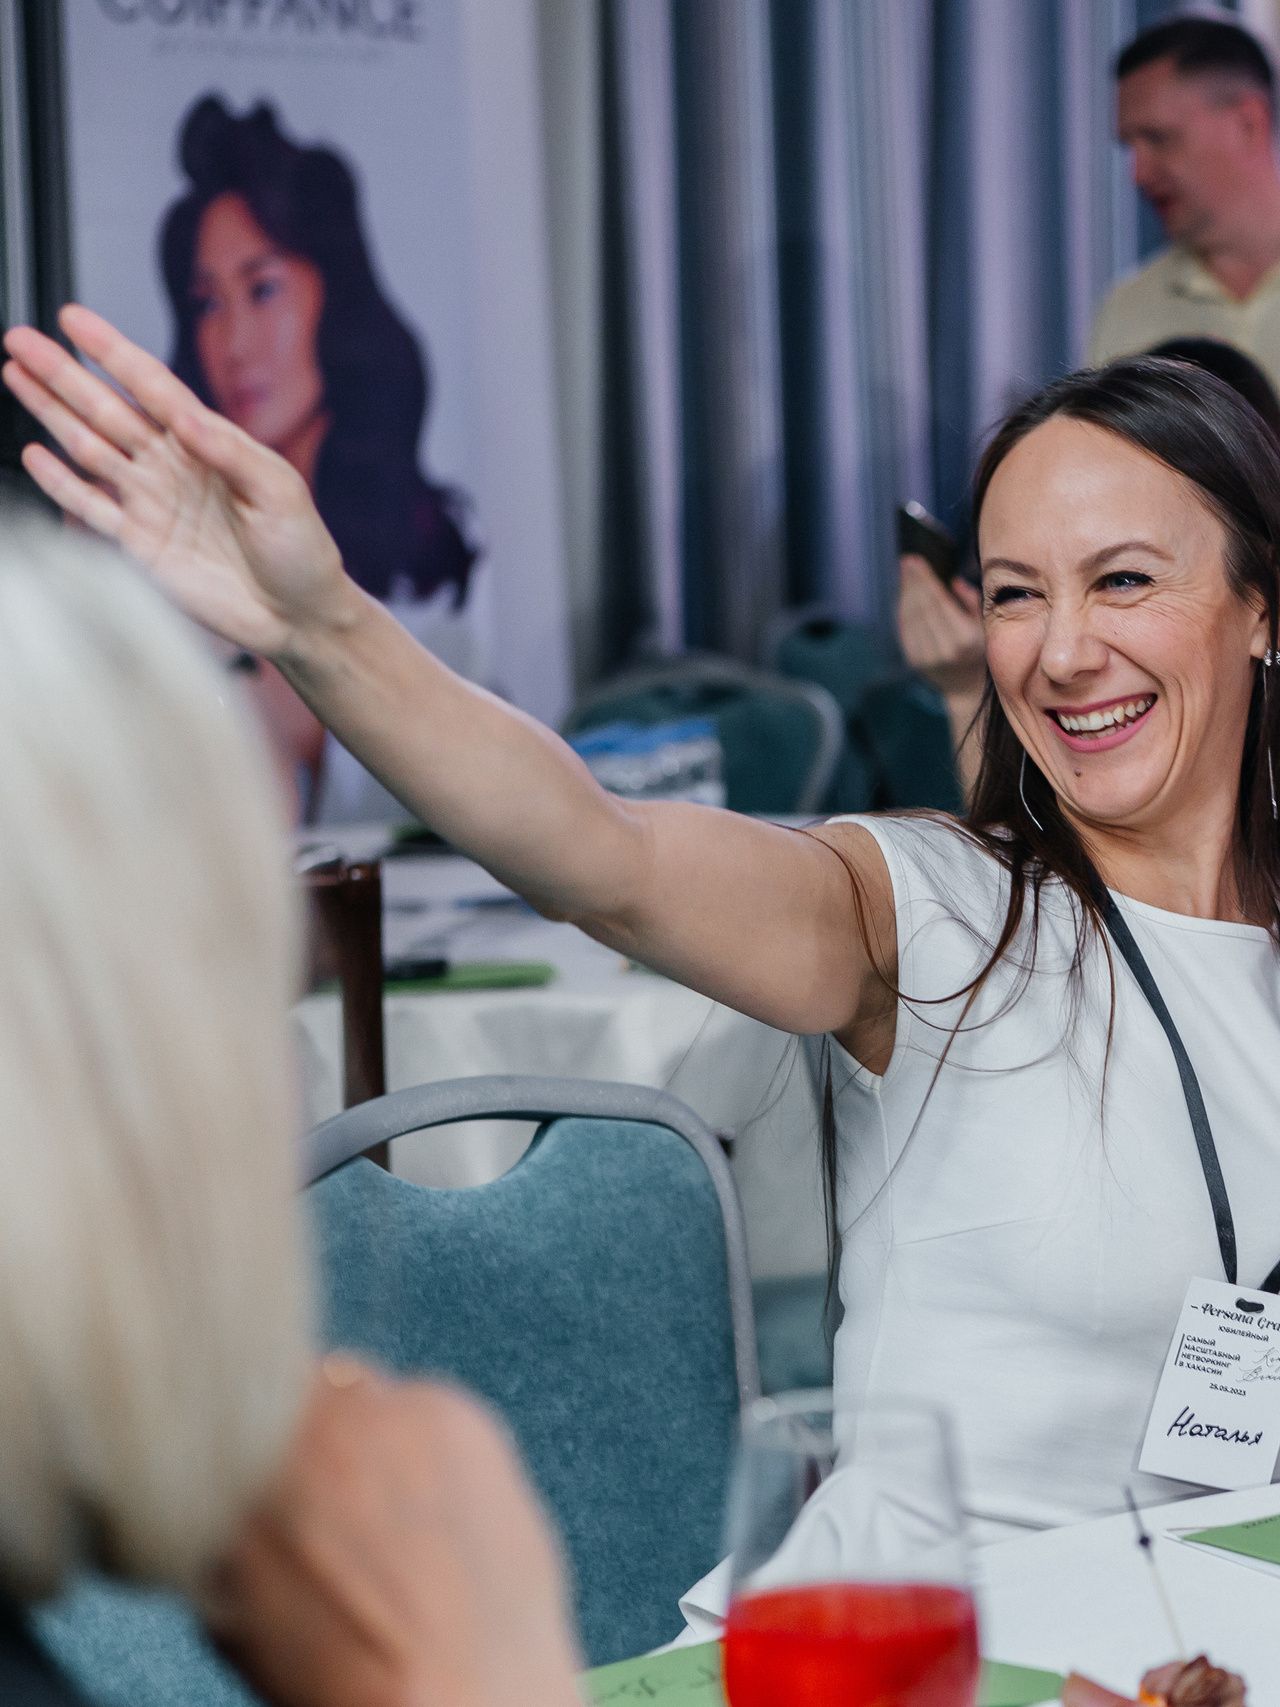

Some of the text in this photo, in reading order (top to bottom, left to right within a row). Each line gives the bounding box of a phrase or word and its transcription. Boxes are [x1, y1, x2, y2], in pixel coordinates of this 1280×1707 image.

[1201, 1303, 1253, 1325] Persona
[1186, 1334, 1216, 1347] САМЫЙ
[1218, 1325, 1270, 1343] ЮБИЛЕЙНЫЙ
[1183, 1344, 1241, 1362] МАСШТАБНЫЙ
[1186, 1362, 1223, 1376] ХАКАСИИ
[1166, 1405, 1263, 1446] Наталья
